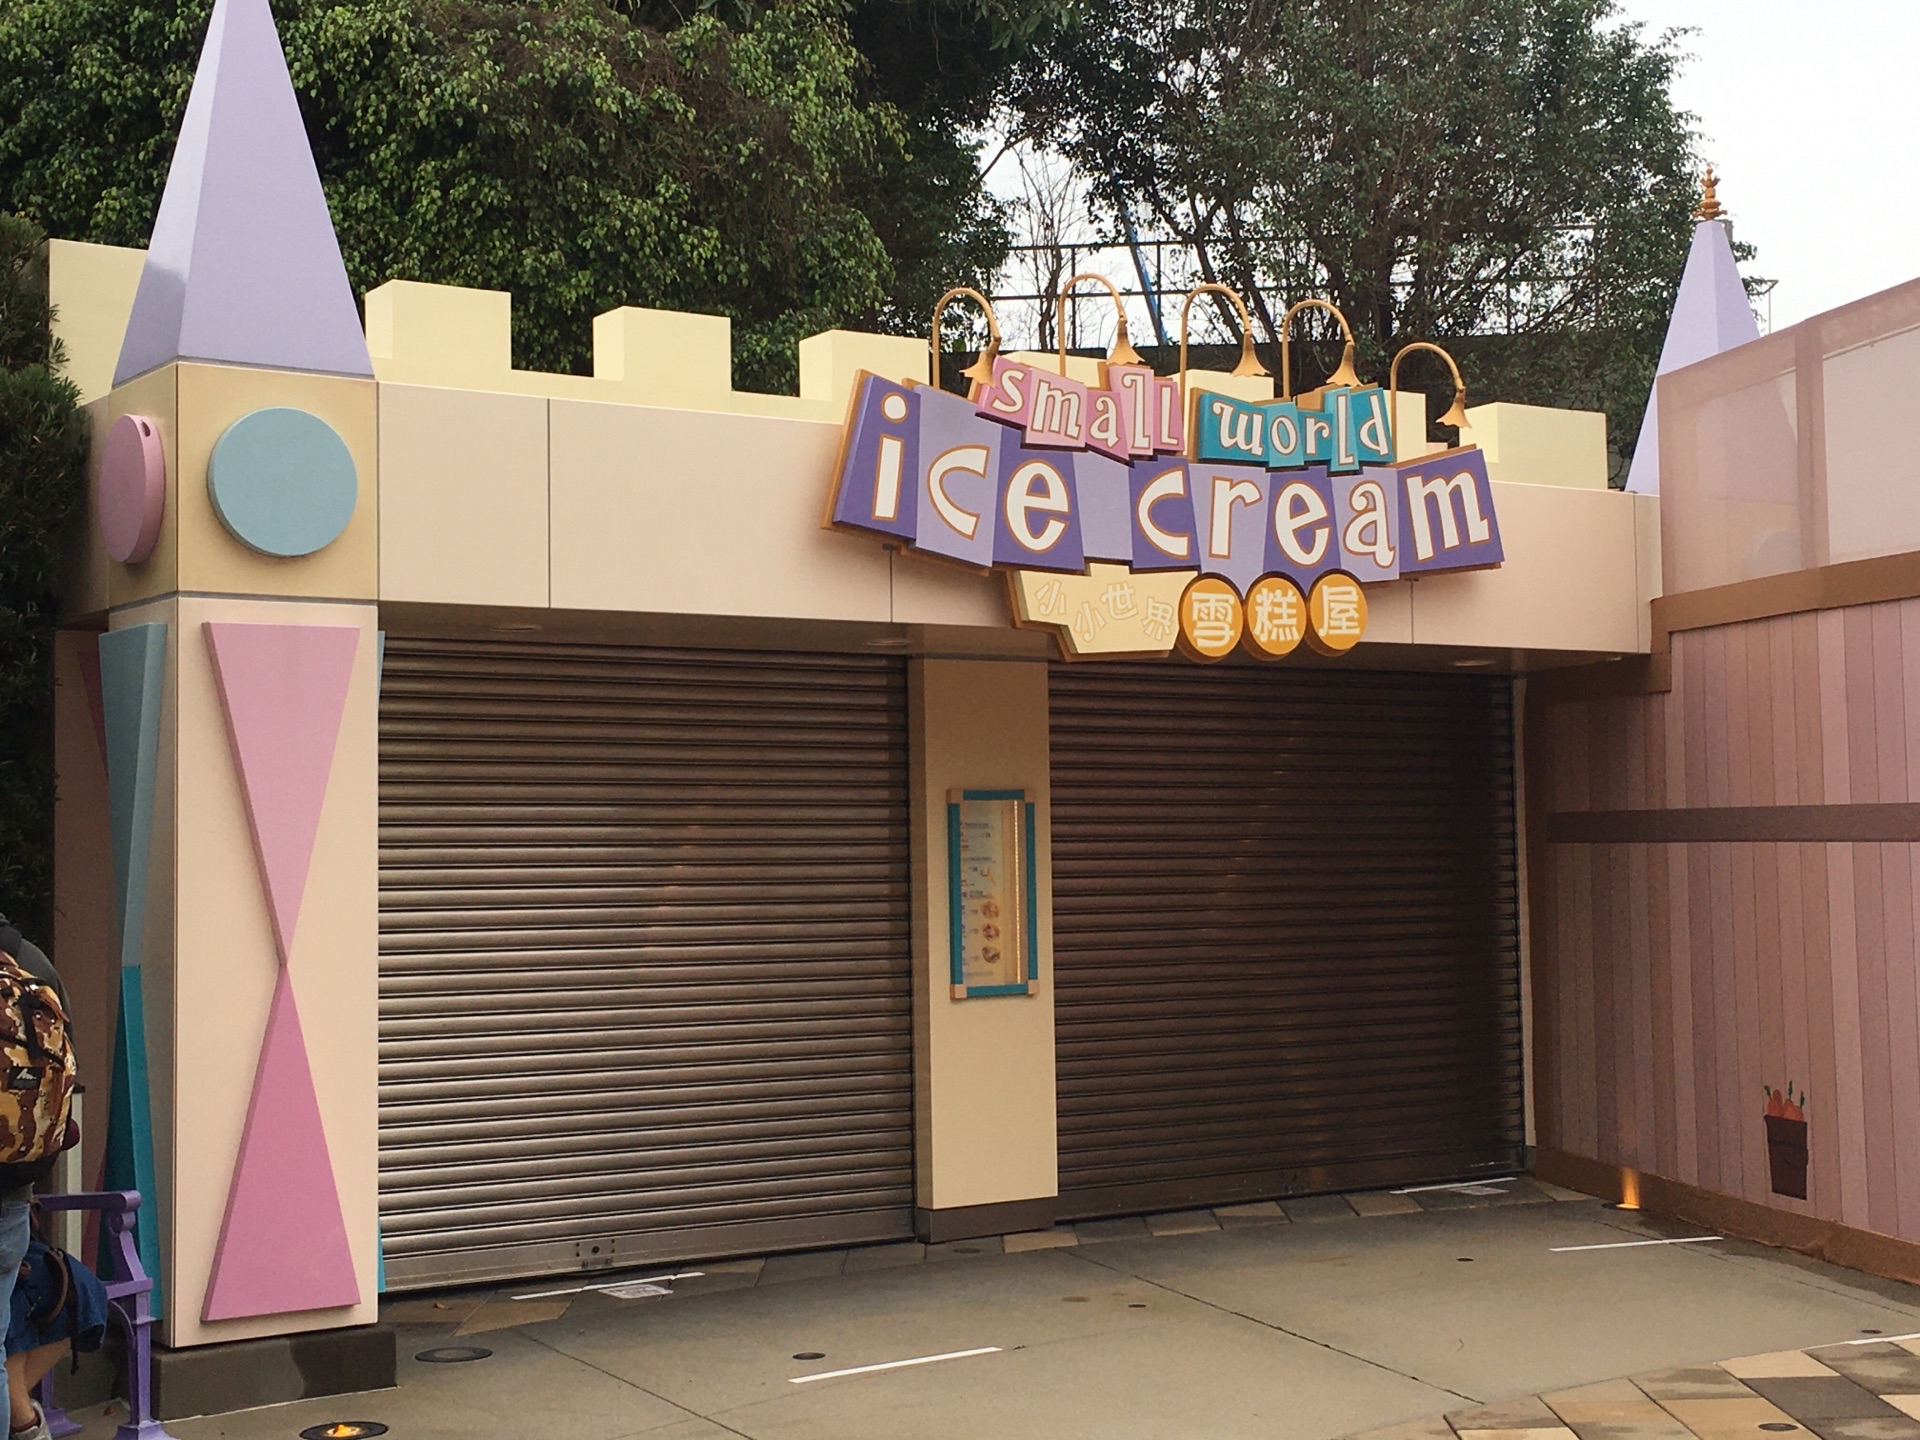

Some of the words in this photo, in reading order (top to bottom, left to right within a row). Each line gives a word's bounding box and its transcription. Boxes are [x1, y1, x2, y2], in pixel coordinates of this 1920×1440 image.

[991, 368, 1180, 450] small
[1211, 392, 1389, 466] world
[872, 394, 1071, 553] ice
[1136, 469, 1491, 568] cream
[1035, 579, 1174, 642] 小小世界
[1191, 585, 1360, 647] 雪糕屋
